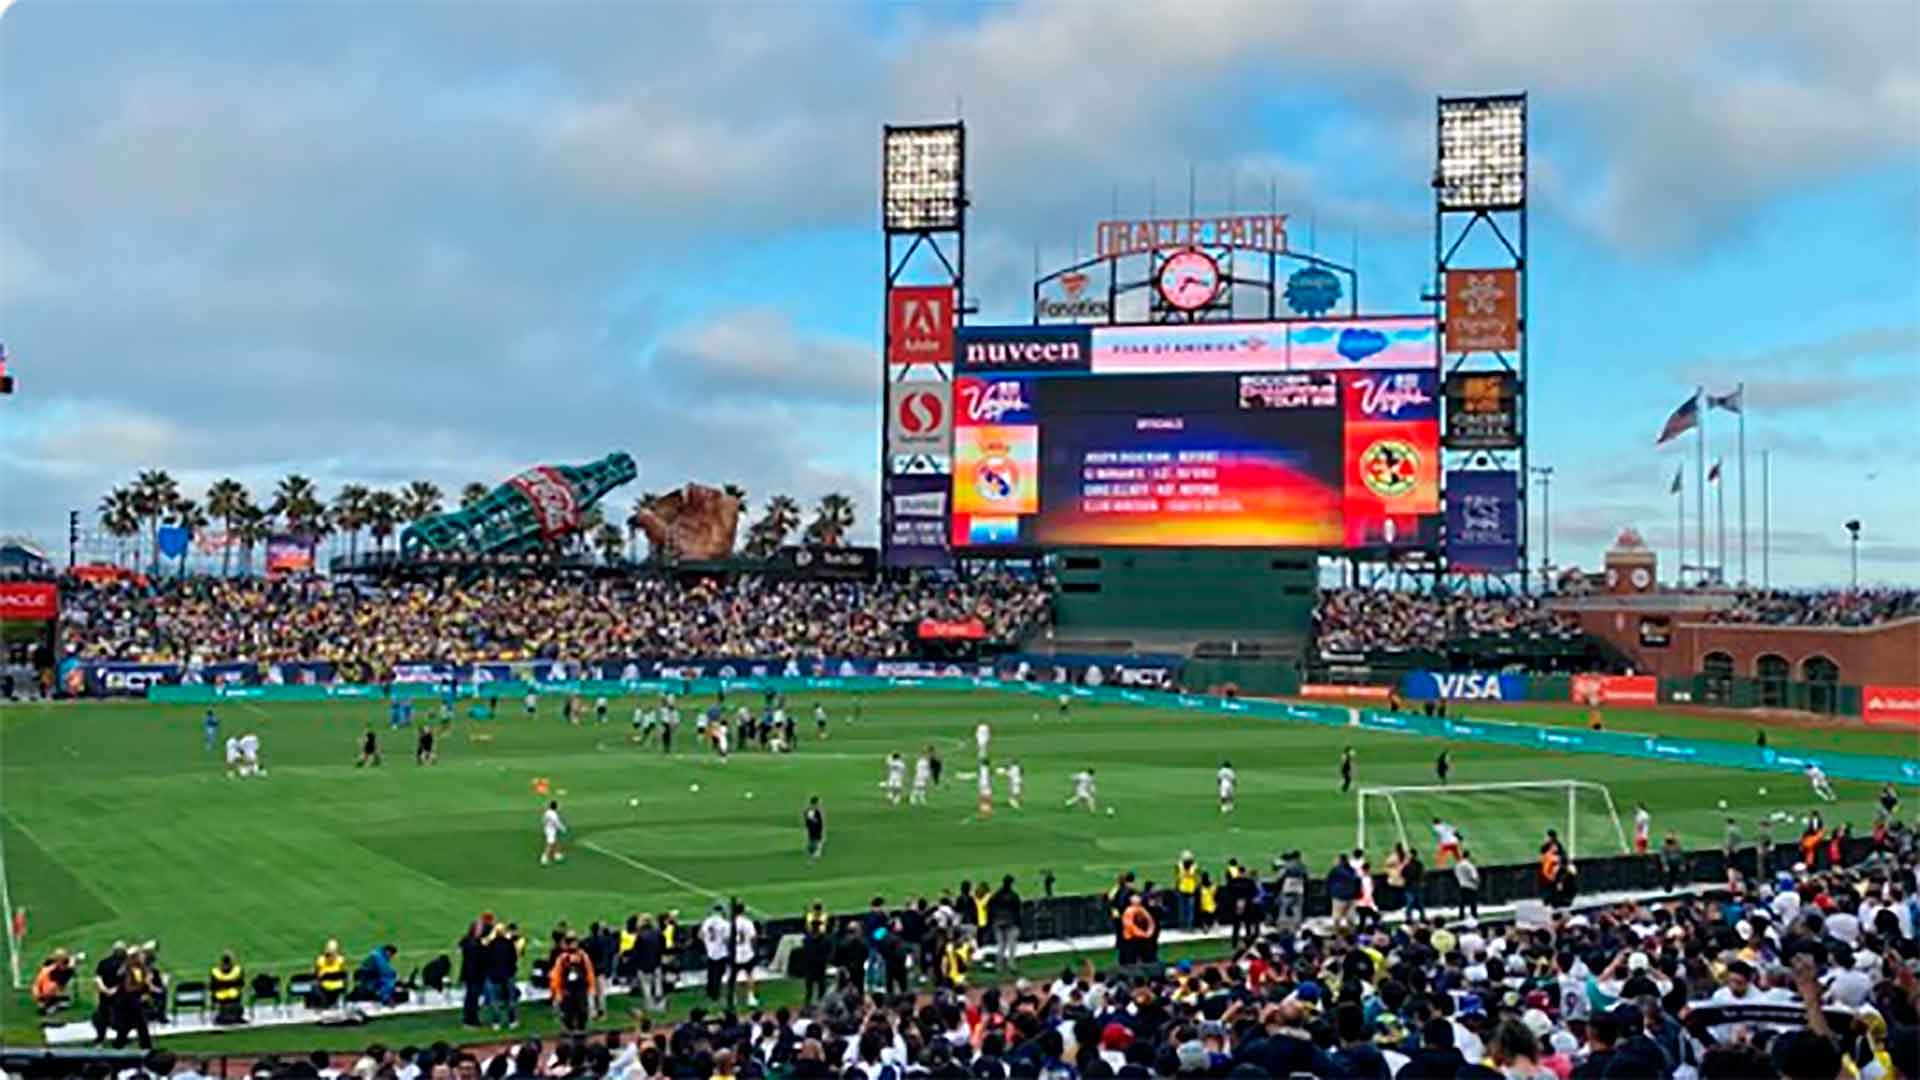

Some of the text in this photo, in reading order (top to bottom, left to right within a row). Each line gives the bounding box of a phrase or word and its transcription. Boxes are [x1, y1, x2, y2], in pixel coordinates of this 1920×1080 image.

[1097, 213, 1288, 255] ORACLE PARK
[1040, 298, 1109, 317] Fanatics
[967, 342, 1079, 362] nuveen
[0, 594, 47, 607] RACLE
[1430, 672, 1502, 698] VISA
